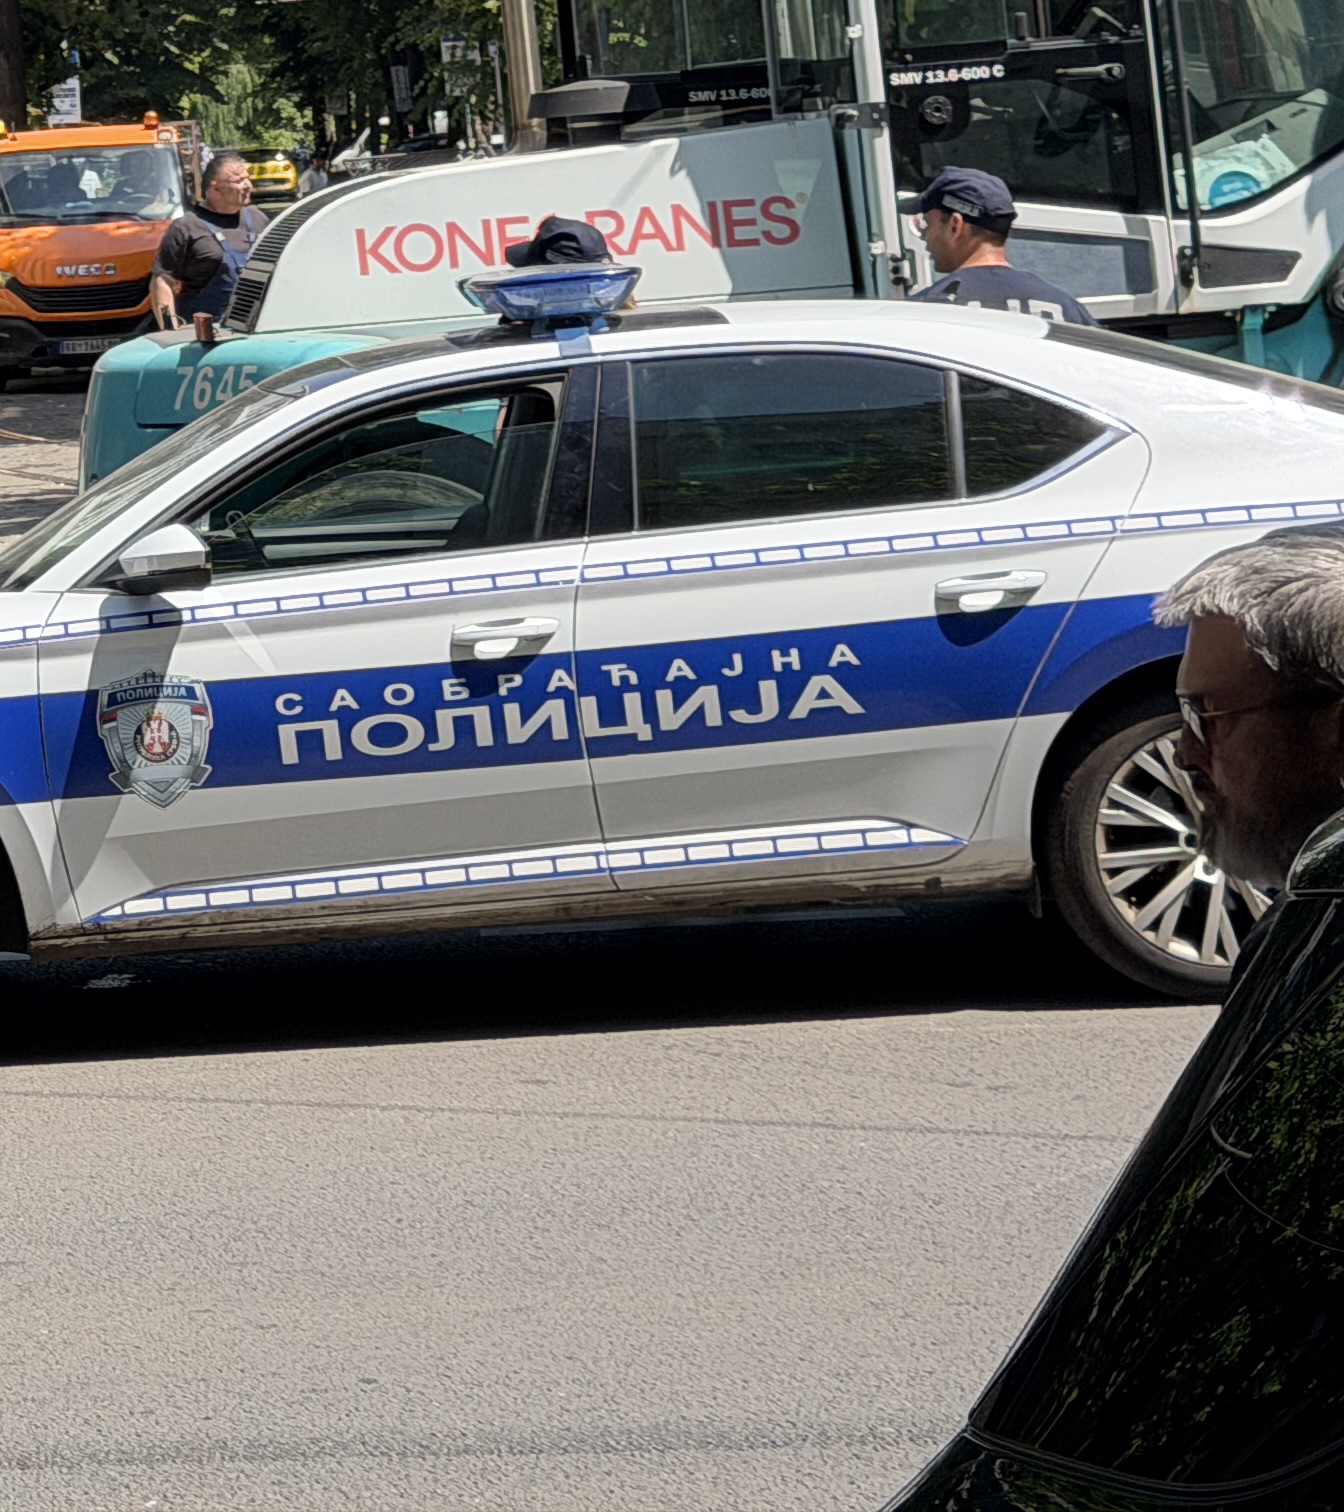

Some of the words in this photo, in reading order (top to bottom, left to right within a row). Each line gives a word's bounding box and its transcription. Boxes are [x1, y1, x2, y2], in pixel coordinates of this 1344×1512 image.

[688, 90, 717, 102] SMV
[889, 71, 923, 86] SMV
[925, 65, 991, 84] 13.6-600
[992, 64, 1005, 78] C
[354, 195, 802, 276] KONERANES
[55, 263, 117, 276] IVECO
[274, 643, 861, 716] САОБРАЋАЈНА
[277, 674, 867, 765] ПОЛИЦИЈА
